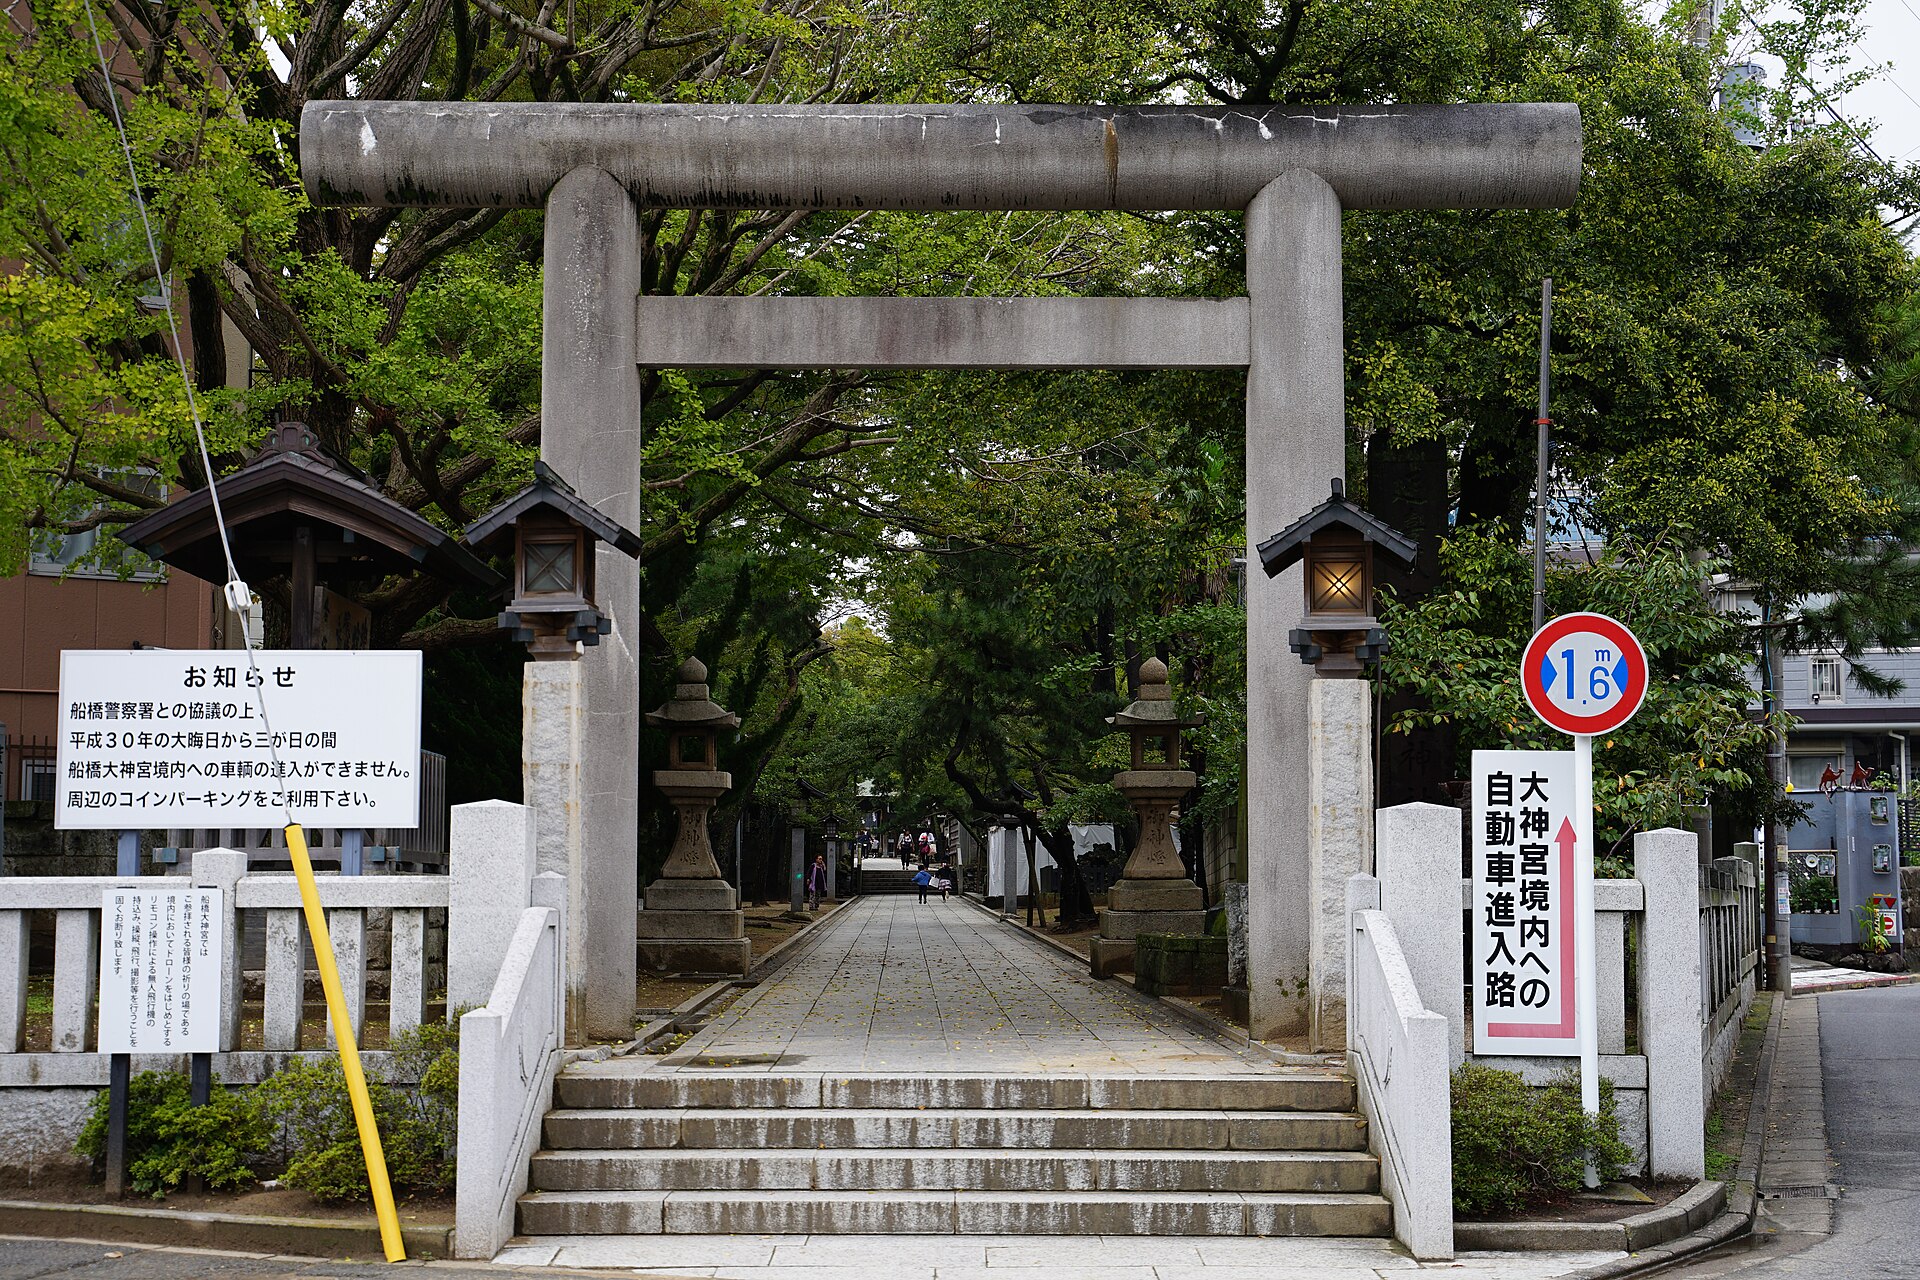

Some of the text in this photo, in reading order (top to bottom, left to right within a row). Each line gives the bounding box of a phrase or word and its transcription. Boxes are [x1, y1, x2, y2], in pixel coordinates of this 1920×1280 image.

[183, 665, 296, 688] お知らせ
[1562, 649, 1611, 704] 1.6 m
[67, 789, 376, 809] 周辺のコインパーキングをご利用下さい。
[1485, 771, 1517, 1008] 自動車進入路
[1519, 771, 1551, 1009] 大神宮境内への
